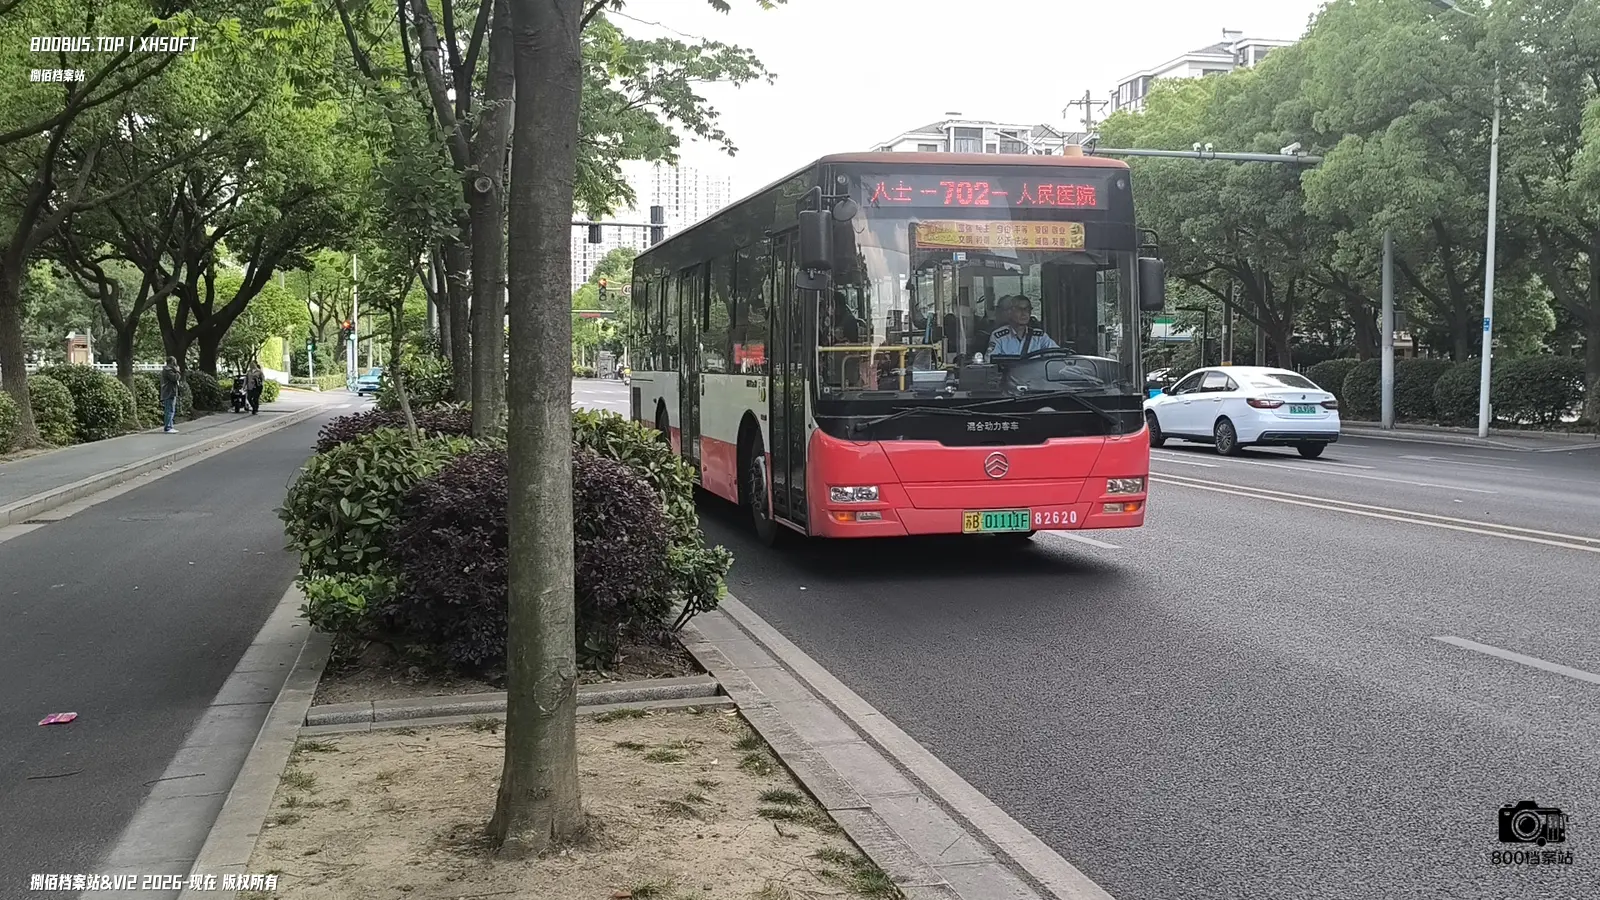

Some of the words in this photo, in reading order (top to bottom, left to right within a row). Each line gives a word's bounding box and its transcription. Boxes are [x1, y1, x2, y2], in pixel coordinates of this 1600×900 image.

[1016, 183, 1096, 206] 人民医院
[967, 422, 1019, 431] 混合动力客车
[1035, 511, 1077, 525] 82620
